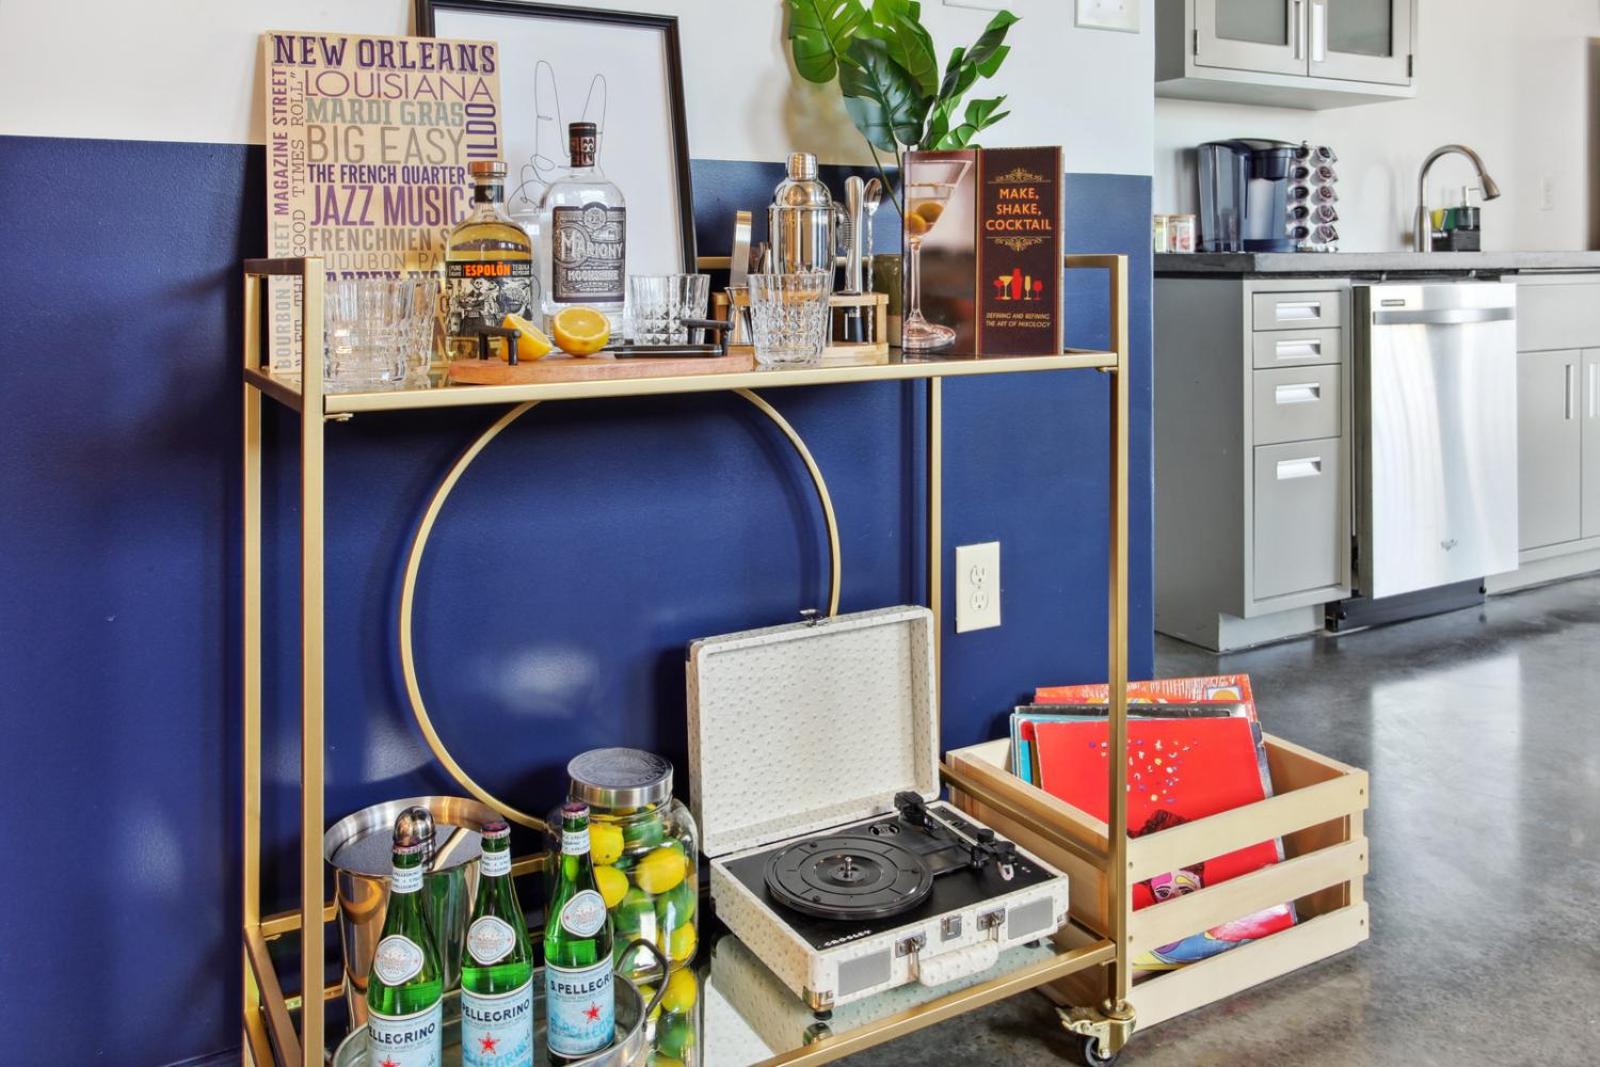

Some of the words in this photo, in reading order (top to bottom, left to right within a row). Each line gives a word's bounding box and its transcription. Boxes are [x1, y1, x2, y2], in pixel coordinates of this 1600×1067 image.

[272, 34, 347, 66] NEW
[358, 38, 496, 74] ORLEANS
[272, 68, 288, 126] STREET
[305, 69, 494, 102] LOUISIANA
[305, 97, 392, 124] MARDI
[400, 100, 464, 127] GRAS
[306, 124, 364, 164] BIG
[380, 126, 465, 165] EASY
[273, 132, 289, 216] MAGAZINE
[291, 139, 305, 198] TIMES
[307, 164, 336, 183] THE
[340, 164, 397, 184] FRENCH
[402, 165, 466, 185] QUARTER
[310, 185, 374, 226] JAZZ
[384, 186, 465, 227] MUSIC
[996, 203, 1042, 216] SHAKE,
[999, 187, 1039, 200] MAKE,
[292, 209, 306, 257] GOOD
[309, 228, 432, 251] FRENCHMEN
[985, 219, 1052, 231] COCKTAIL
[274, 222, 290, 282] SREET
[313, 252, 406, 270] UDUBON
[275, 289, 291, 369] BOURBON
